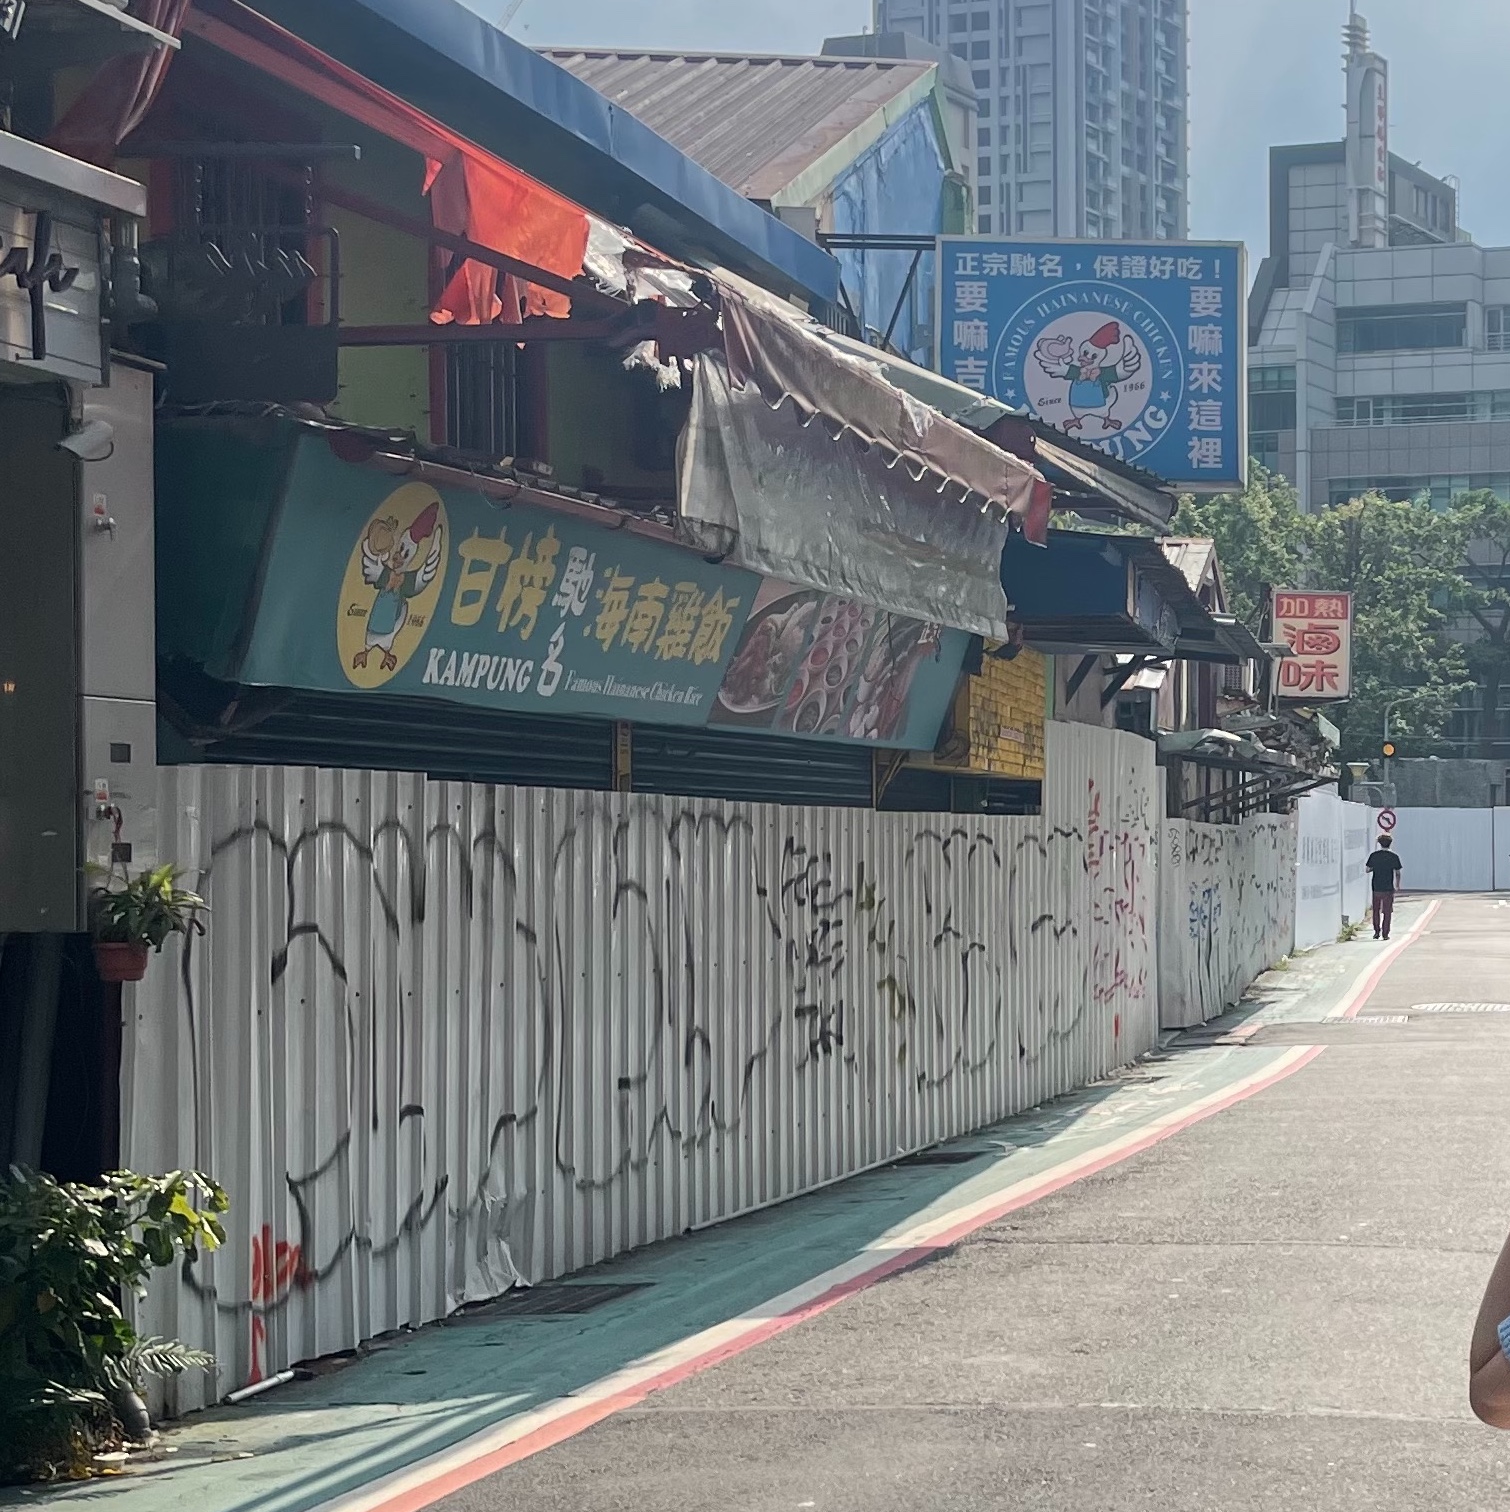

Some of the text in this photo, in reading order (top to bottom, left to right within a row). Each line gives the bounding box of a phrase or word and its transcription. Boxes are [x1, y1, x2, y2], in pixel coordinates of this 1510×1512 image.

[1002, 290, 1173, 382] FAMOUS HAINANESE CHICKEN
[1187, 286, 1223, 469] 要嘛來這裡
[451, 523, 561, 641] 甘榜
[583, 564, 741, 666] 海南雞飯
[1280, 597, 1343, 617] 加熱
[422, 647, 534, 693] KAMPUNG
[1282, 623, 1341, 692] 滷味
